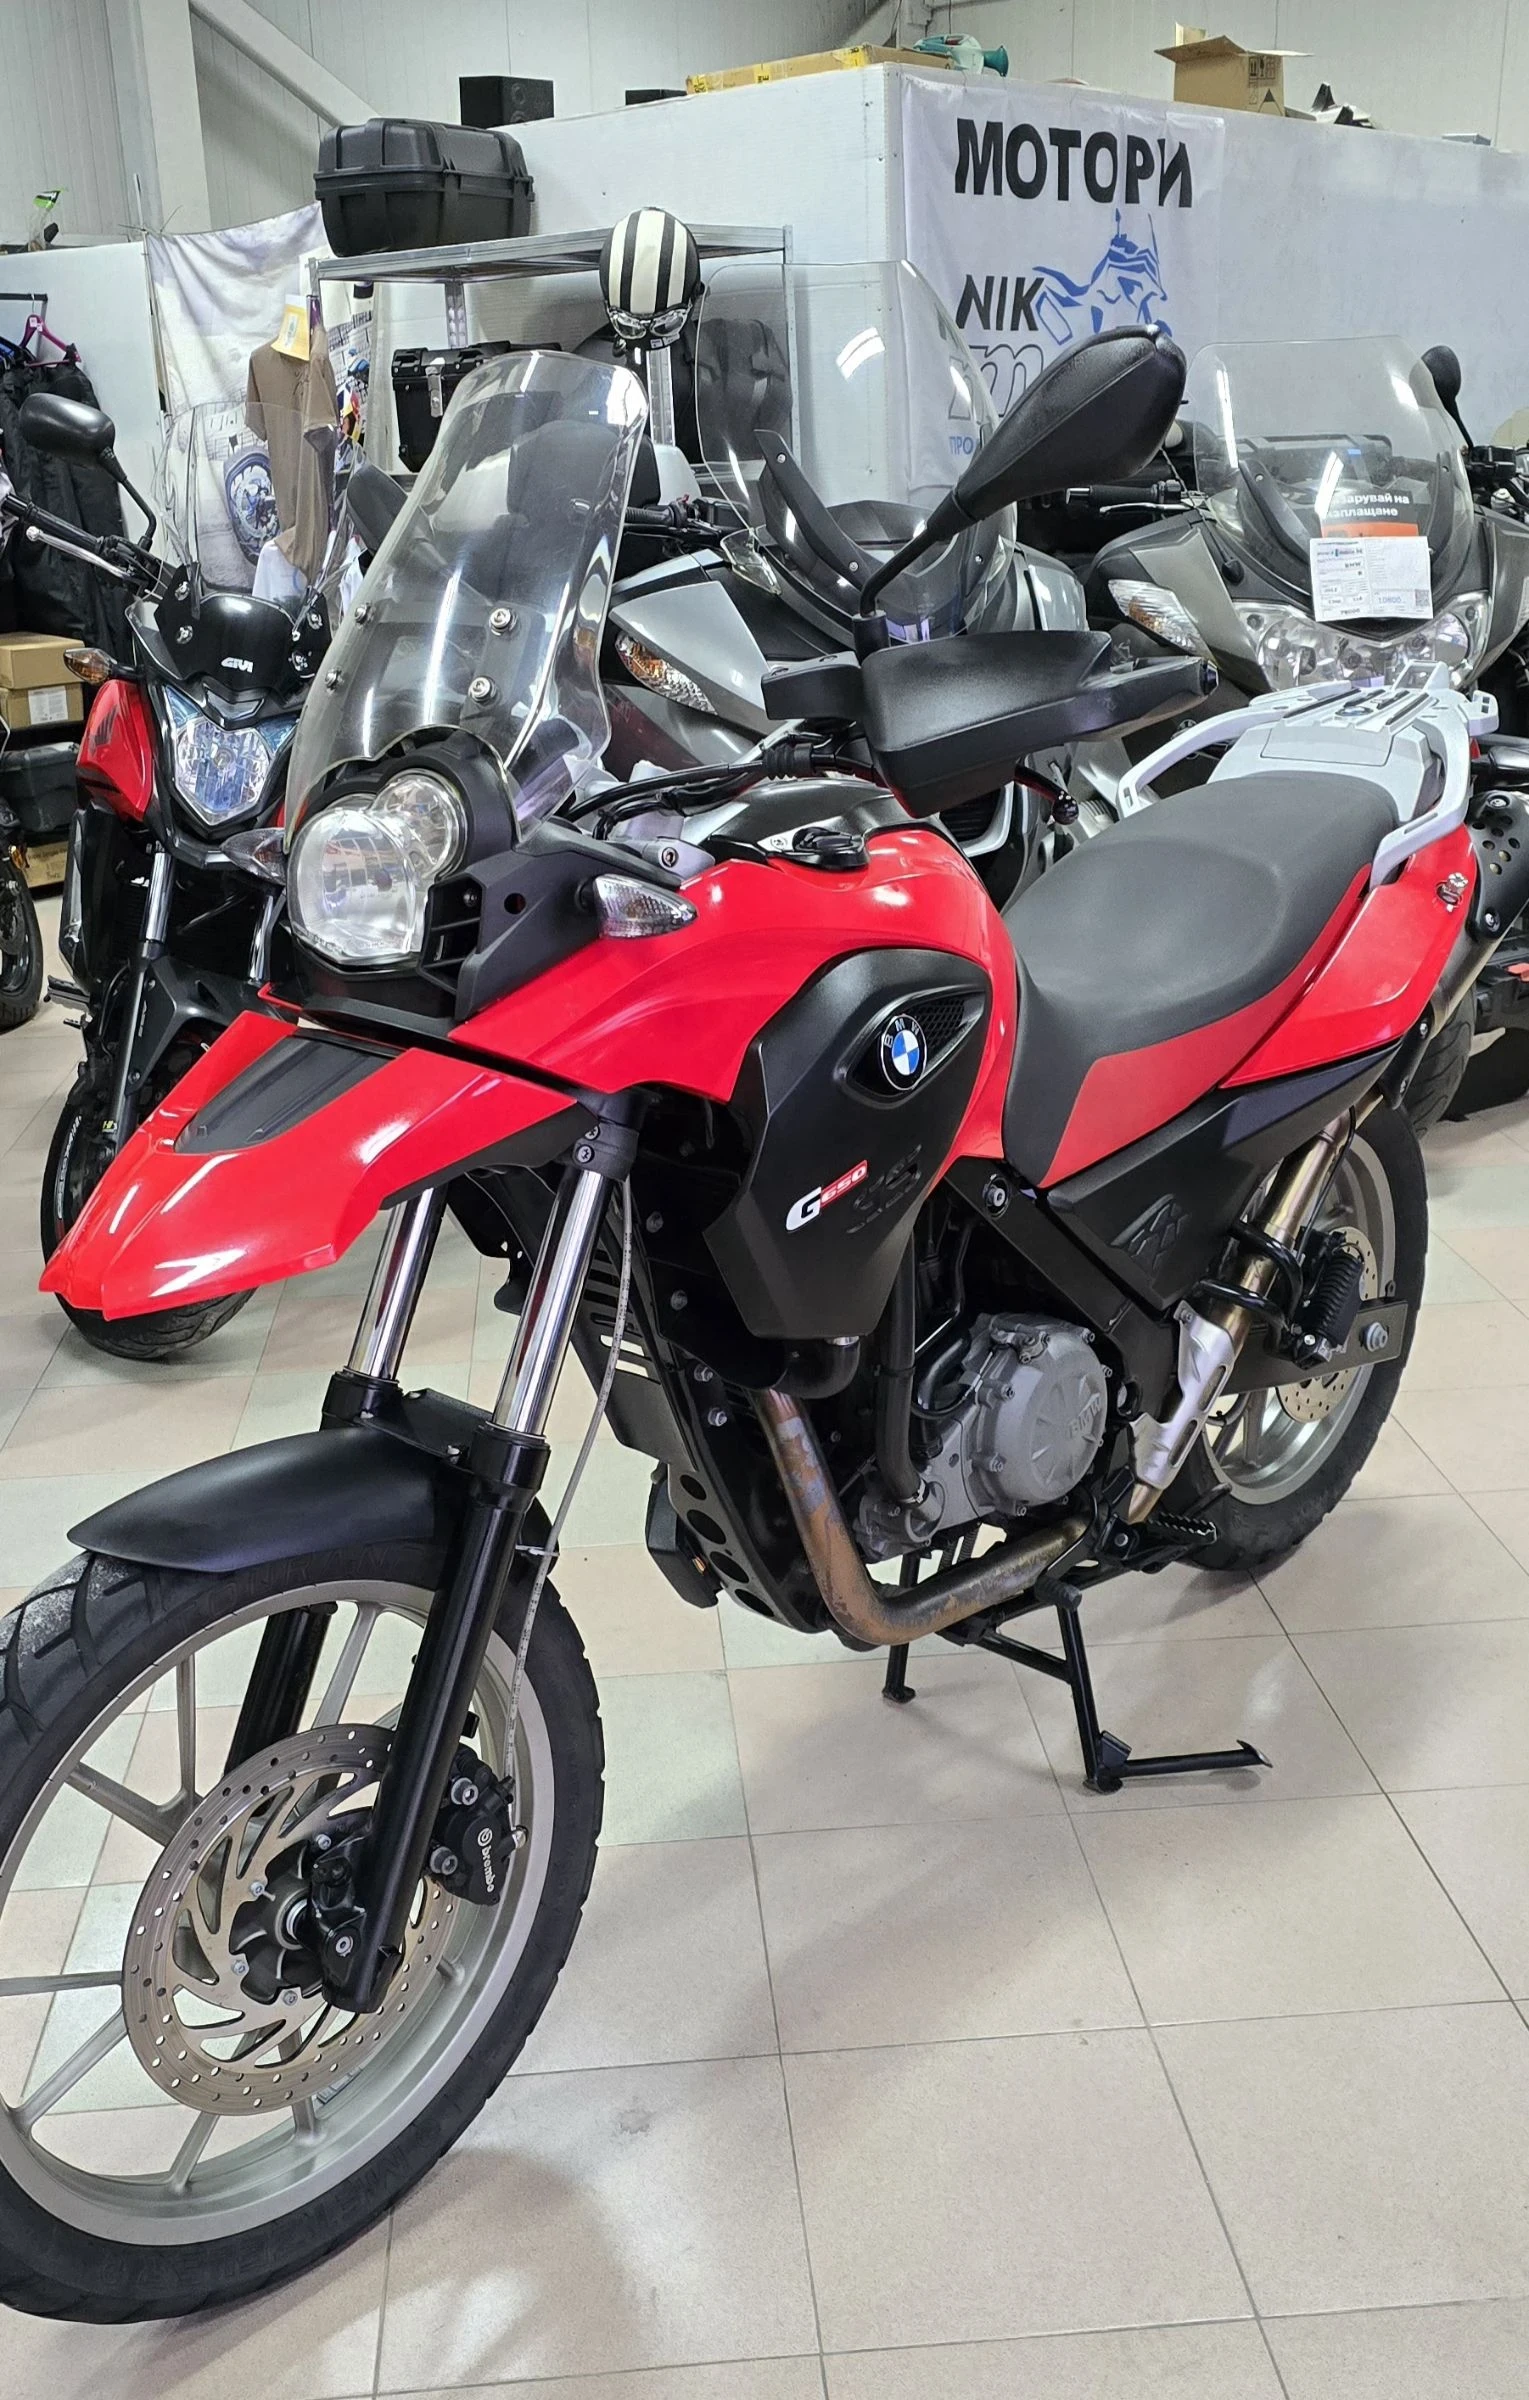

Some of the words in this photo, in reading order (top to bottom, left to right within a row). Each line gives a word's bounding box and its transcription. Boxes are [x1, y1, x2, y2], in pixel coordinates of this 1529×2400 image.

[955, 117, 1192, 208] МОТОРИ
[956, 274, 1045, 331] NIK
[1394, 495, 1410, 505] на
[221, 656, 254, 673] GIVI
[482, 1845, 496, 1893] brembo
